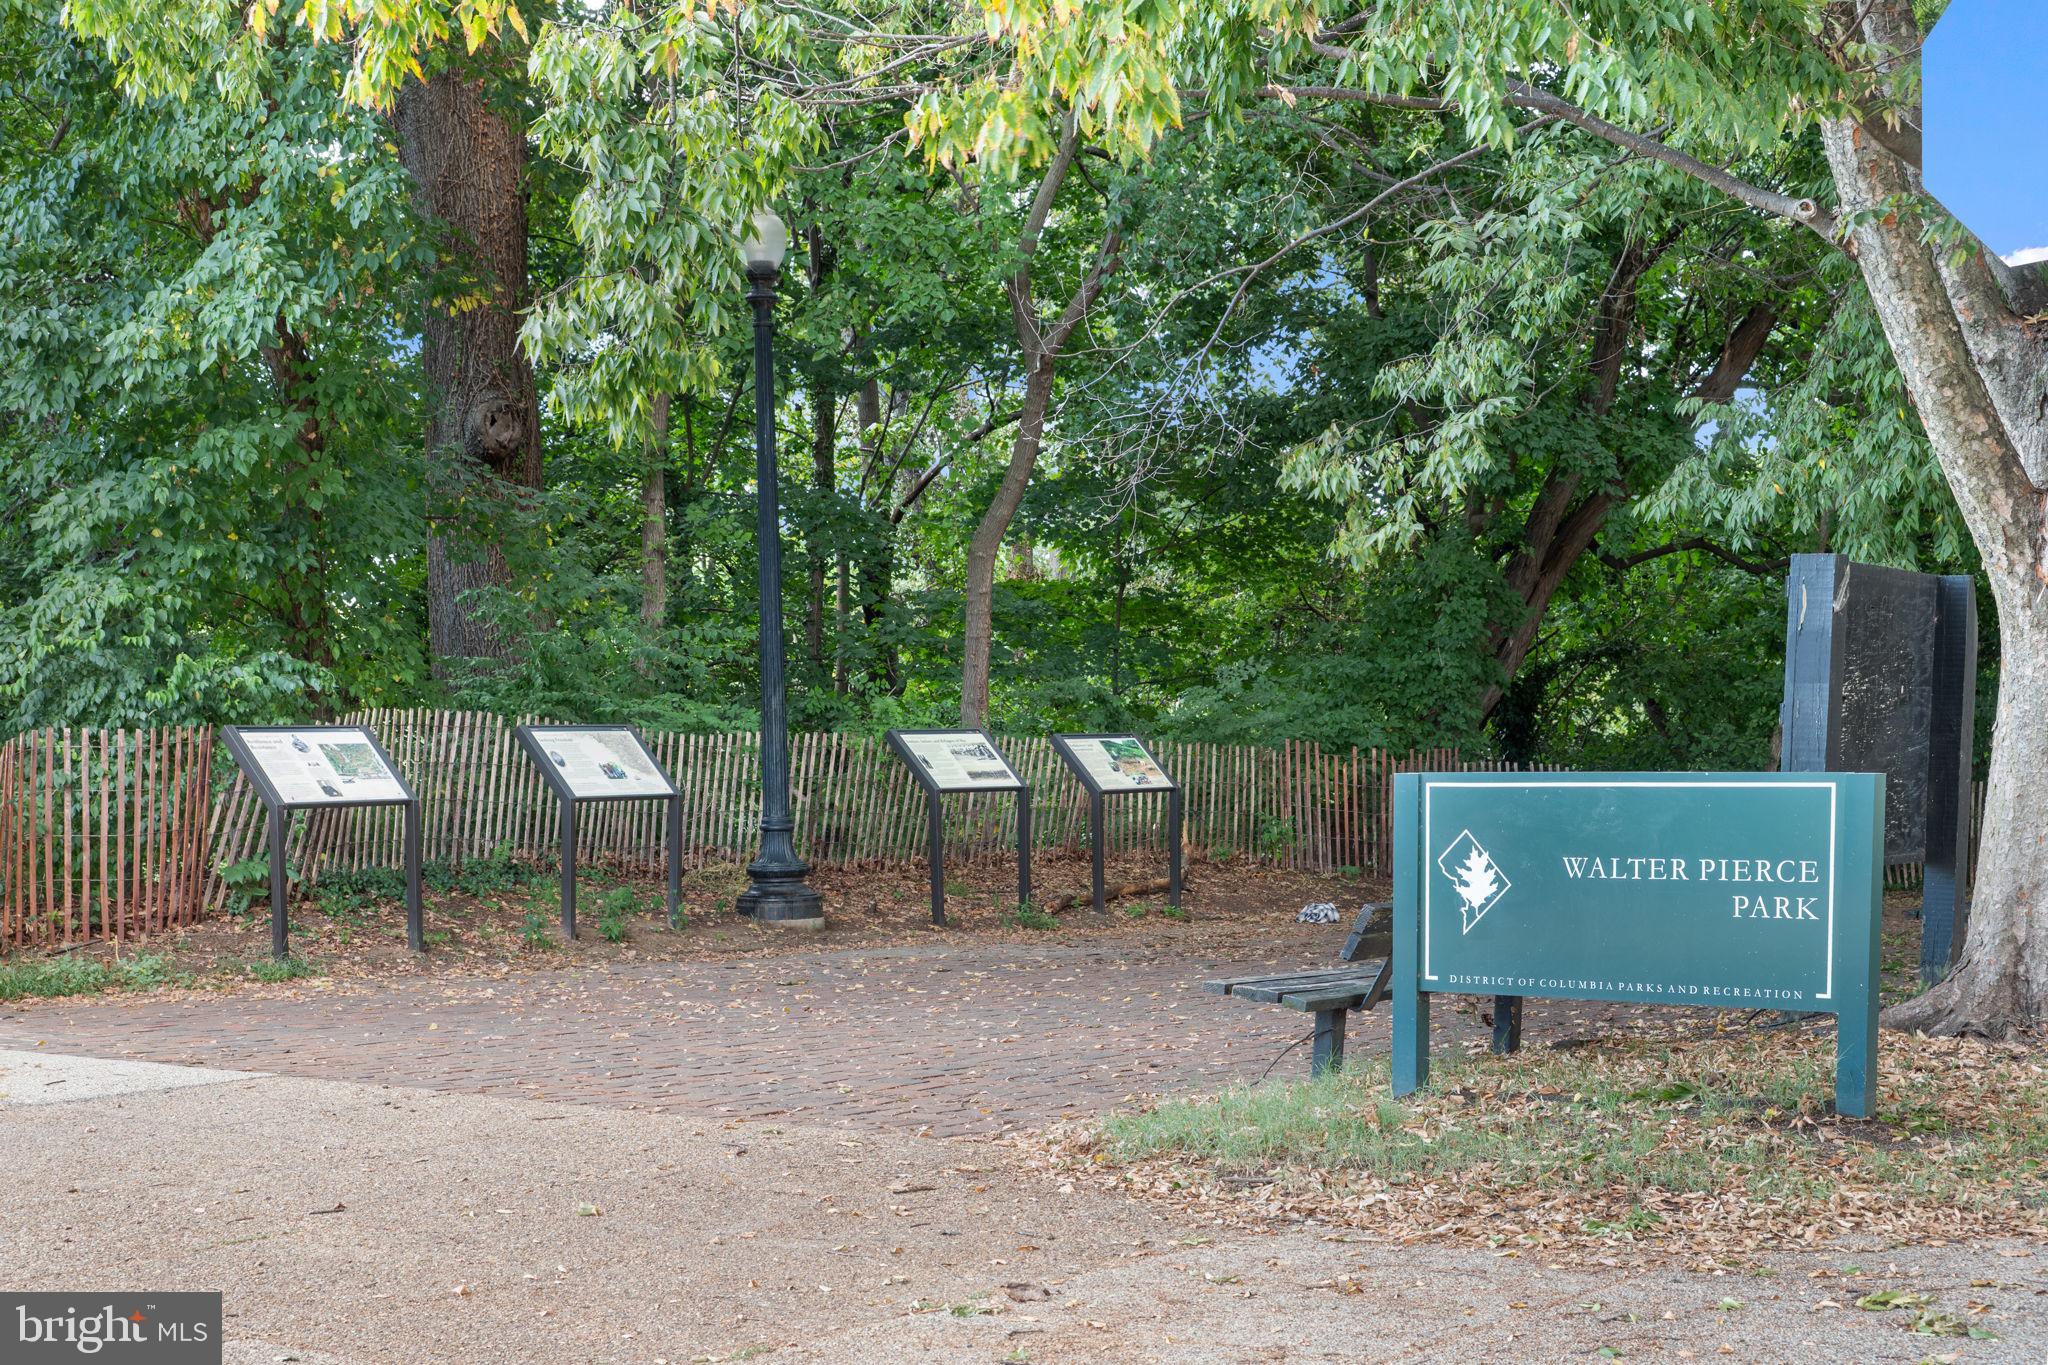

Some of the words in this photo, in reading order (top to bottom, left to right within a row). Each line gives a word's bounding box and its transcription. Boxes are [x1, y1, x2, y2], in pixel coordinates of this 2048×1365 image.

[1562, 856, 1689, 881] WALTER
[1698, 858, 1819, 883] PIERCE
[1731, 895, 1819, 920] PARK
[1448, 974, 1515, 987] DISTRICT
[1518, 977, 1536, 987] OF
[1539, 978, 1614, 991] COLUMBIA
[1618, 981, 1663, 993] PARKS
[1667, 984, 1698, 995] AND
[1703, 986, 1803, 1000] RECREATION
